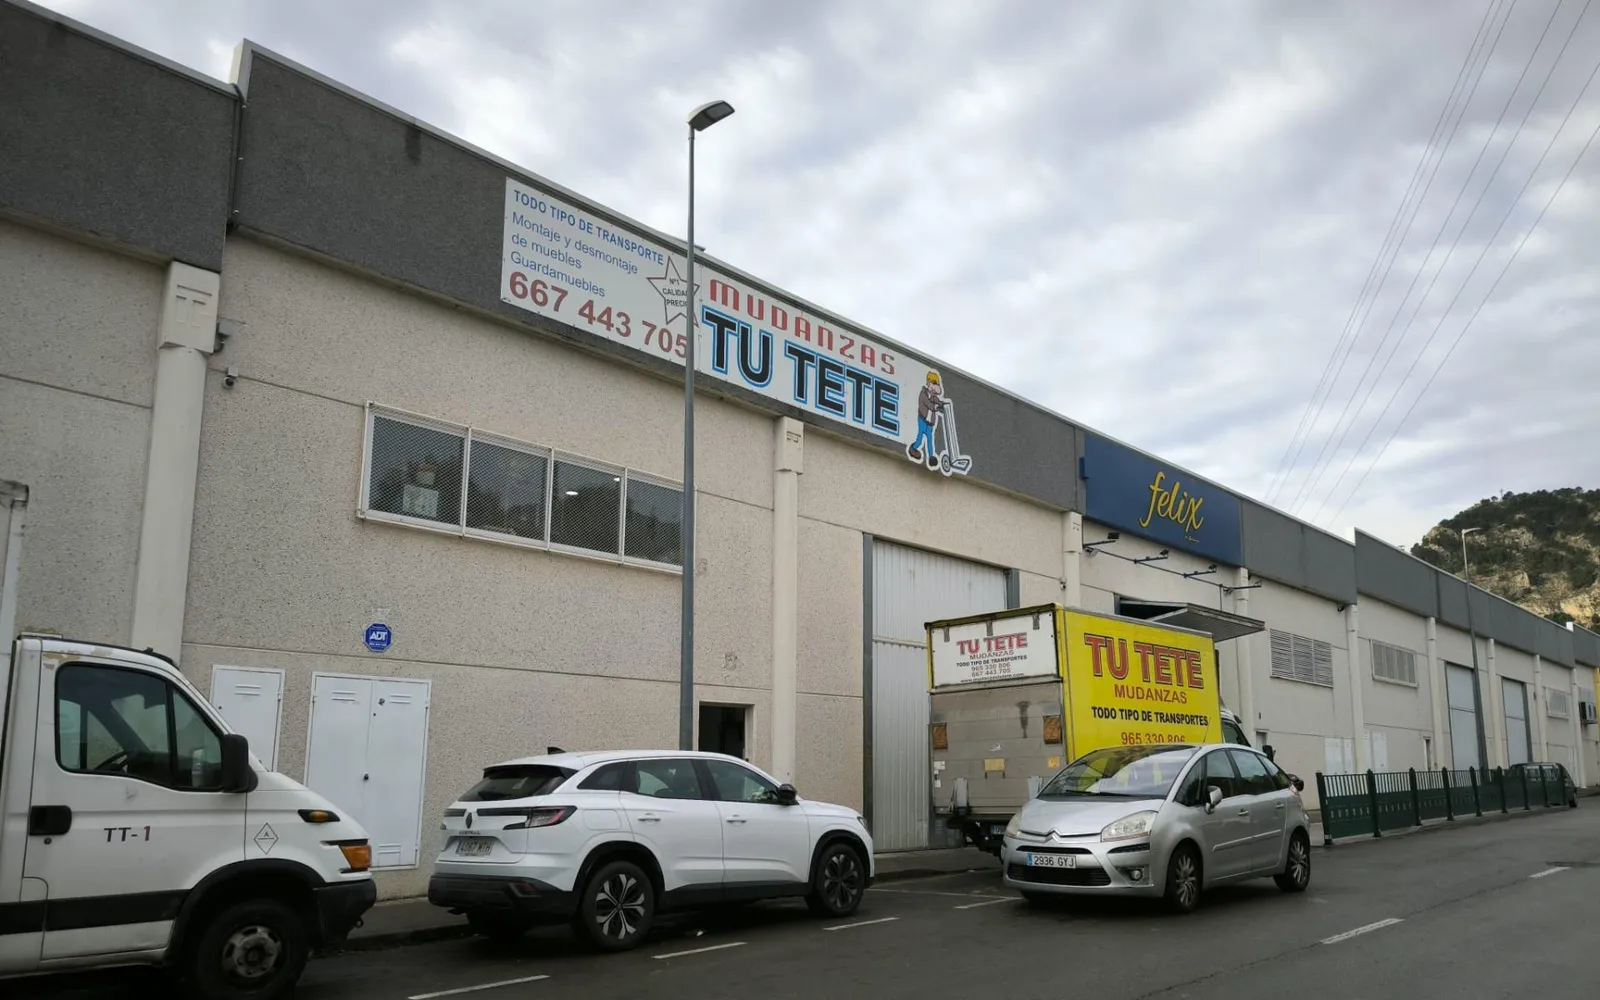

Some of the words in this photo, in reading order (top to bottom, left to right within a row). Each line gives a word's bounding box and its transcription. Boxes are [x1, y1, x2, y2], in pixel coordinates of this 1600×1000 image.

[514, 190, 547, 214] TODO
[550, 206, 576, 226] TIPO
[579, 219, 593, 234] DE
[597, 226, 664, 266] TRANSPORTE
[512, 212, 560, 242] Montaje
[564, 235, 571, 247] y
[574, 238, 638, 274] desmontaje
[512, 234, 528, 248] de
[532, 241, 582, 269] muebles
[511, 251, 606, 297] Guardamuebles
[662, 288, 688, 296] CALIDA
[510, 271, 568, 312] 667
[578, 300, 632, 338] 443
[642, 320, 688, 359] 705
[710, 279, 895, 375] MUDANZAS
[702, 305, 774, 388] TU
[784, 340, 899, 436] TETE
[1140, 472, 1204, 532] felix
[370, 631, 388, 640] ADT
[956, 639, 980, 656] TU
[984, 632, 1028, 652] TETE
[970, 650, 1014, 660] MUDANZAS
[992, 655, 1027, 663] TRANSPORTES
[1084, 633, 1128, 680] TU
[1134, 641, 1204, 689] TETE
[1114, 684, 1188, 704] MUDANZAS
[1092, 706, 1116, 720] TODO
[1119, 709, 1139, 720] TIPO
[1142, 711, 1152, 722] DE
[1154, 712, 1208, 726] TRANSPORTES
[1121, 732, 1142, 745] 965
[1034, 856, 1054, 866] 2936
[1058, 857, 1074, 867] GYJ
